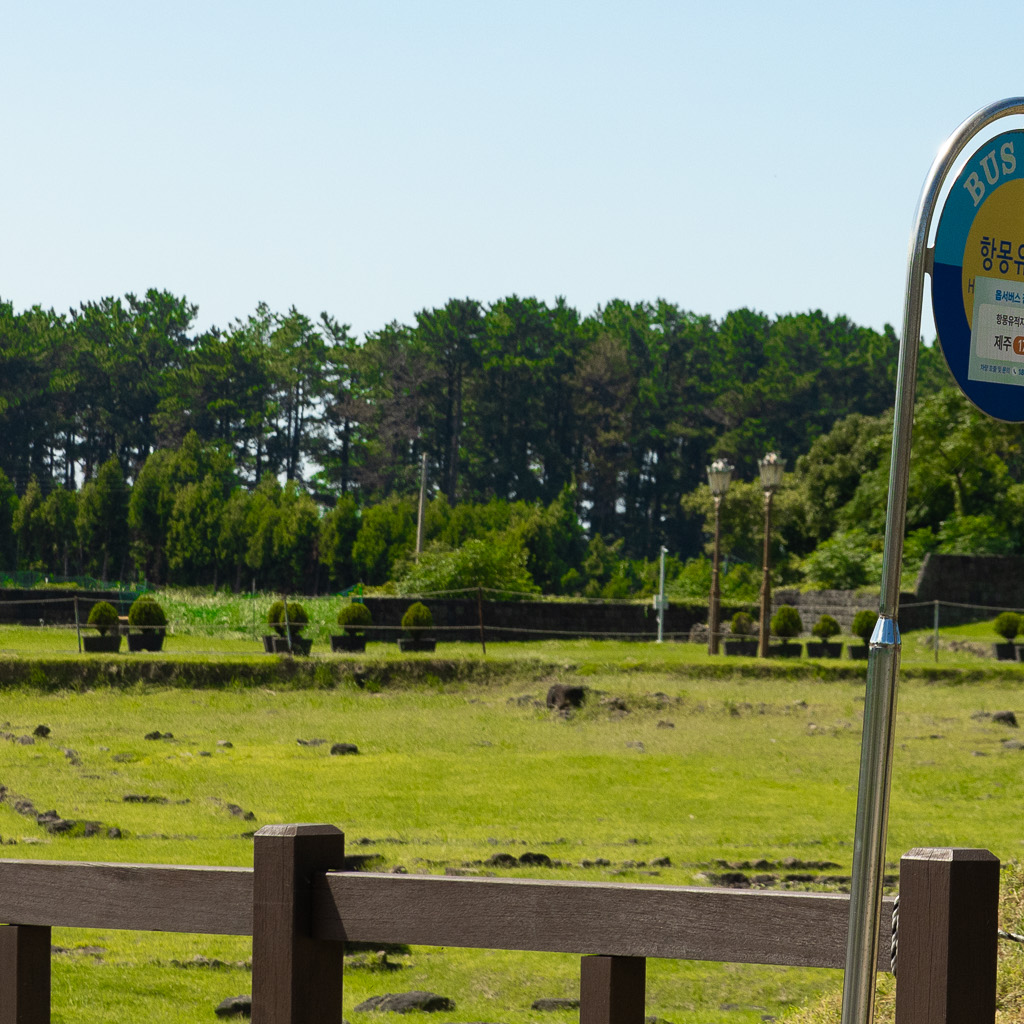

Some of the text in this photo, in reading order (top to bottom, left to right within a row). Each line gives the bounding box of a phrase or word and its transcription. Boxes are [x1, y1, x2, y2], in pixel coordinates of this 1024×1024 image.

[963, 141, 1017, 207] BUS
[995, 289, 1021, 303] 옵서버스
[994, 334, 1012, 352] 제주
